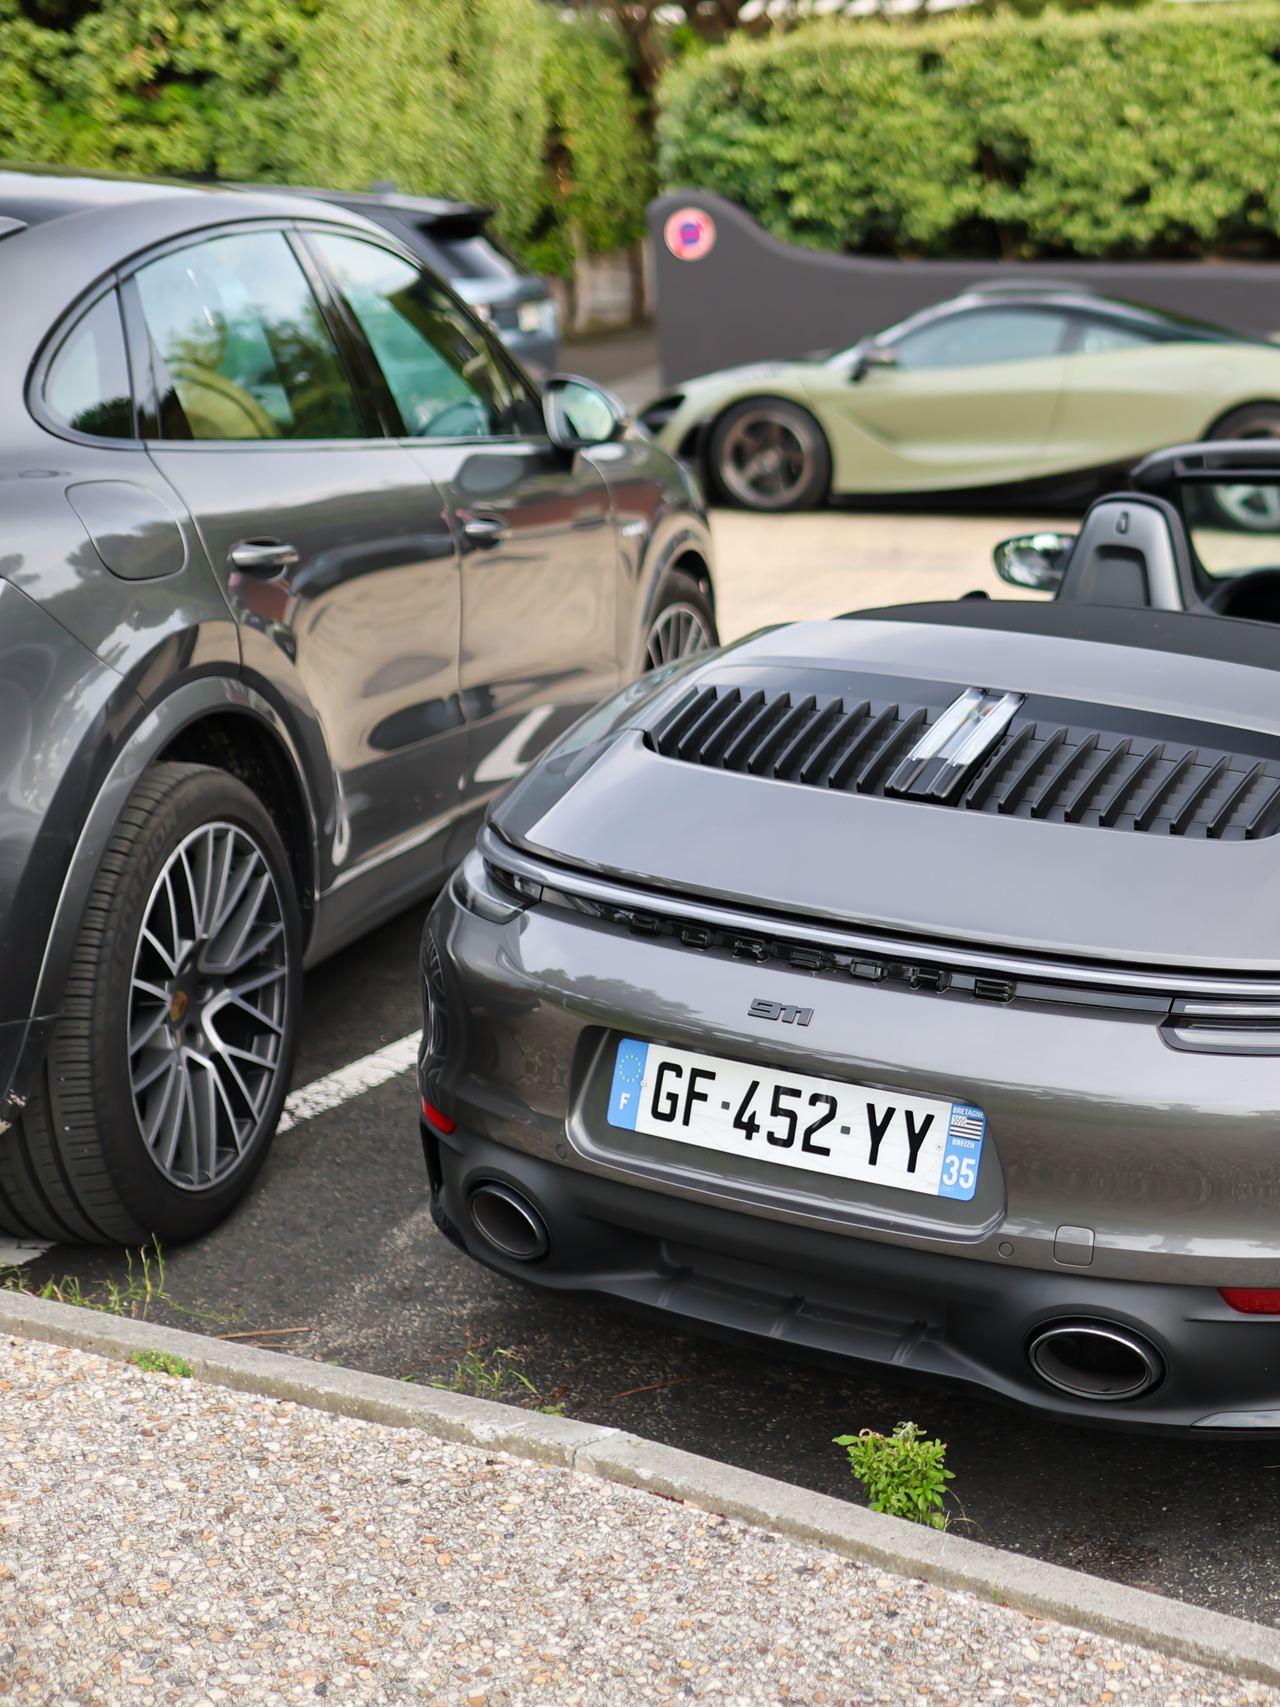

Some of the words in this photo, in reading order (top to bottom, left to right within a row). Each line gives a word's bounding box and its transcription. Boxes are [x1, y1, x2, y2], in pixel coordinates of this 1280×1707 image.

[629, 912, 1014, 1004] PORSCHE
[747, 998, 814, 1027] 911
[619, 1092, 631, 1110] F
[952, 1106, 985, 1119] BRETAGNE
[951, 1138, 976, 1149] BREIZH
[942, 1154, 977, 1189] 35
